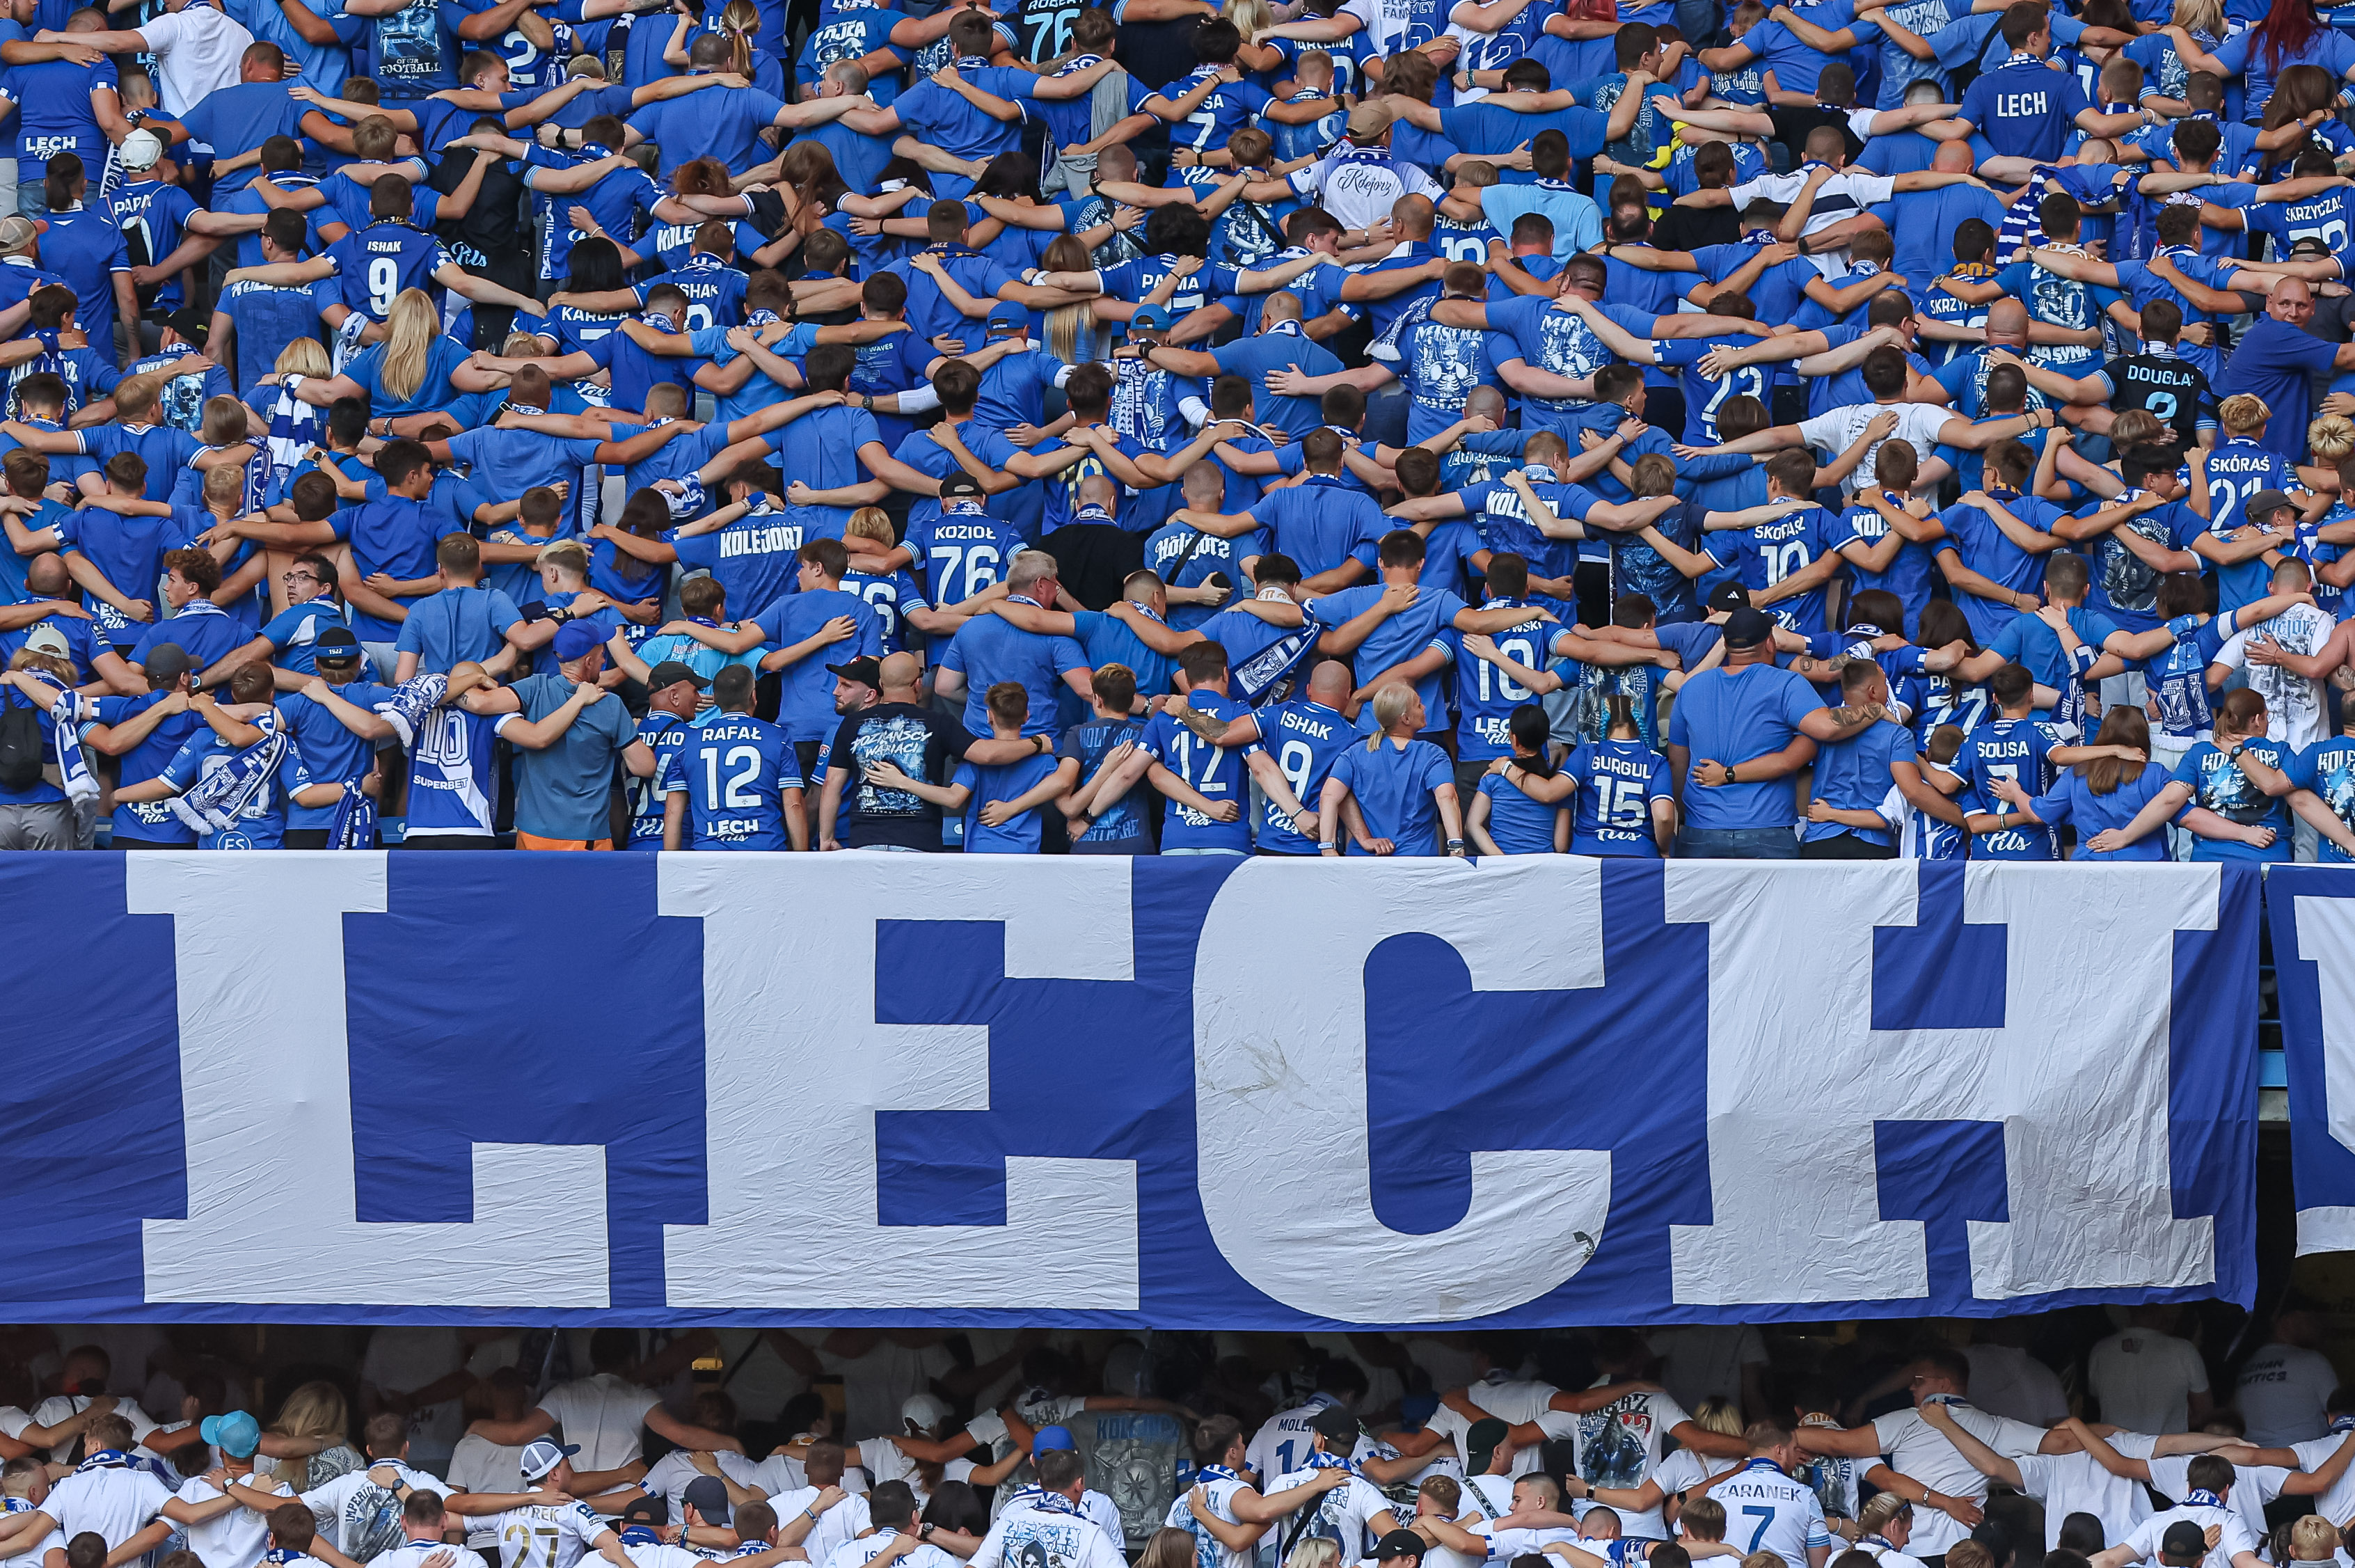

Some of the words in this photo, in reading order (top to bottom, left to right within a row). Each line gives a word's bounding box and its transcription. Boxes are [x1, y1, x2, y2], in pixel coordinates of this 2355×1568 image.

[379, 63, 442, 75] FOOTBALL
[502, 31, 542, 84] 2
[1178, 89, 1224, 110] SSA
[1997, 92, 2047, 117] LECH
[26, 136, 77, 152] LECH
[1187, 112, 1215, 154] 7
[114, 199, 151, 215] PAPA
[371, 241, 404, 252] ISHAK
[450, 241, 487, 267] Pils
[372, 258, 402, 315] 9
[1142, 274, 1198, 291] PAMA
[868, 343, 894, 353] WAVES
[2210, 454, 2268, 473] SKÓRAŚ
[935, 525, 997, 541] KOZIOŁ
[930, 545, 999, 599] 76
[1761, 539, 1809, 589] 10
[102, 615, 129, 630] Pils
[328, 648, 342, 656] 1922
[1478, 638, 1535, 702] 10
[1280, 710, 1333, 741] ISHAK
[1475, 718, 1511, 734] LEC
[1926, 688, 1988, 742] 77
[415, 706, 468, 767] 10
[701, 727, 763, 742] RAFAŁ
[1977, 741, 2031, 758] SOUSA
[1172, 731, 1227, 792] 12
[1279, 739, 1313, 800] 9
[1591, 756, 1652, 780] GURGUL
[413, 774, 468, 791] SUPERBET
[700, 745, 762, 810] 12
[1986, 763, 2018, 815] 7
[1594, 775, 1646, 828] 15
[140, 812, 170, 825] Pils
[707, 818, 759, 836] LECH
[1981, 830, 2031, 853] Pils
[126, 851, 2221, 1323] LECH
[1718, 1484, 1802, 1503] ZARANEK
[1742, 1505, 1775, 1557] 7
[505, 1524, 560, 1568] 27
[865, 1551, 908, 1568] ISK
